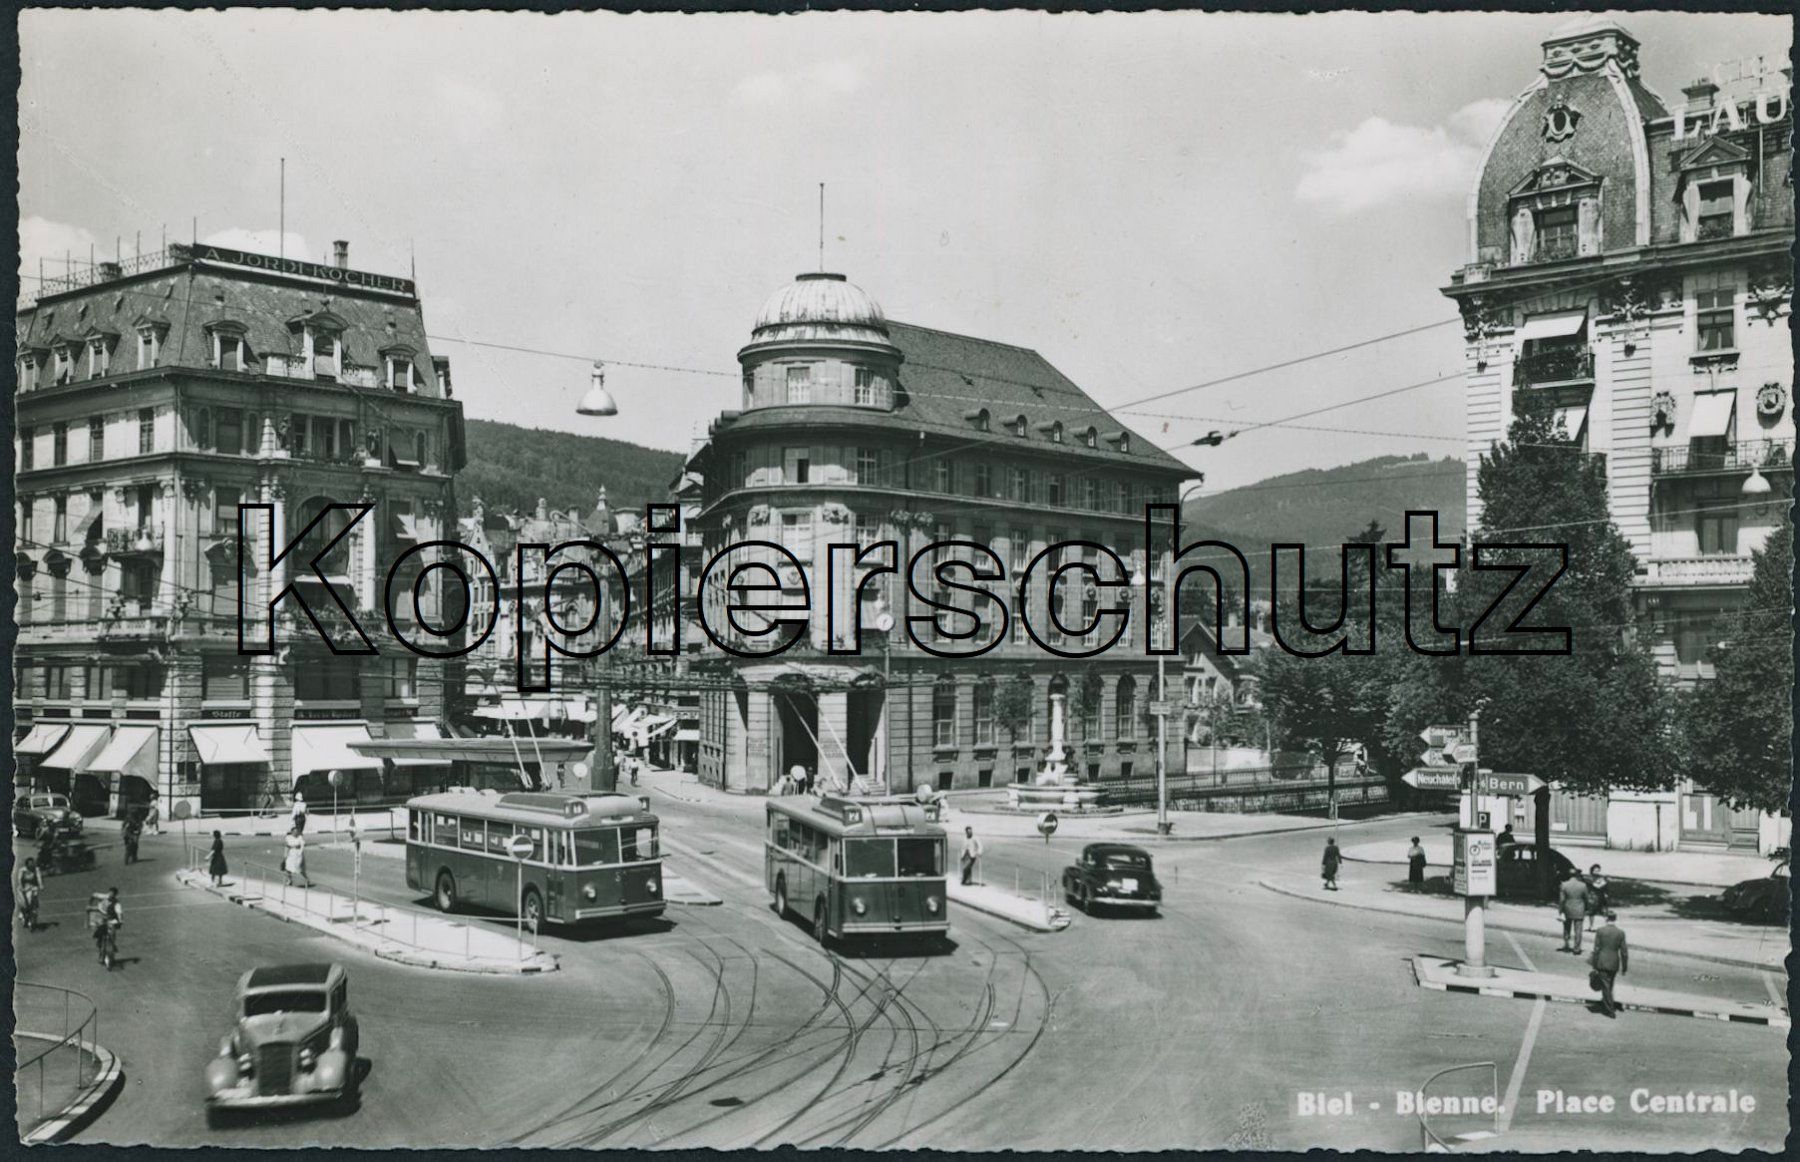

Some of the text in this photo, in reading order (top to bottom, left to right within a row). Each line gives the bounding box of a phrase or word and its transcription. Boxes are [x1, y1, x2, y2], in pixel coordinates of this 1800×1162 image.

[205, 248, 407, 291] A. JORDI-KOCHER
[1489, 777, 1525, 791] Bern
[1479, 813, 1488, 824] P
